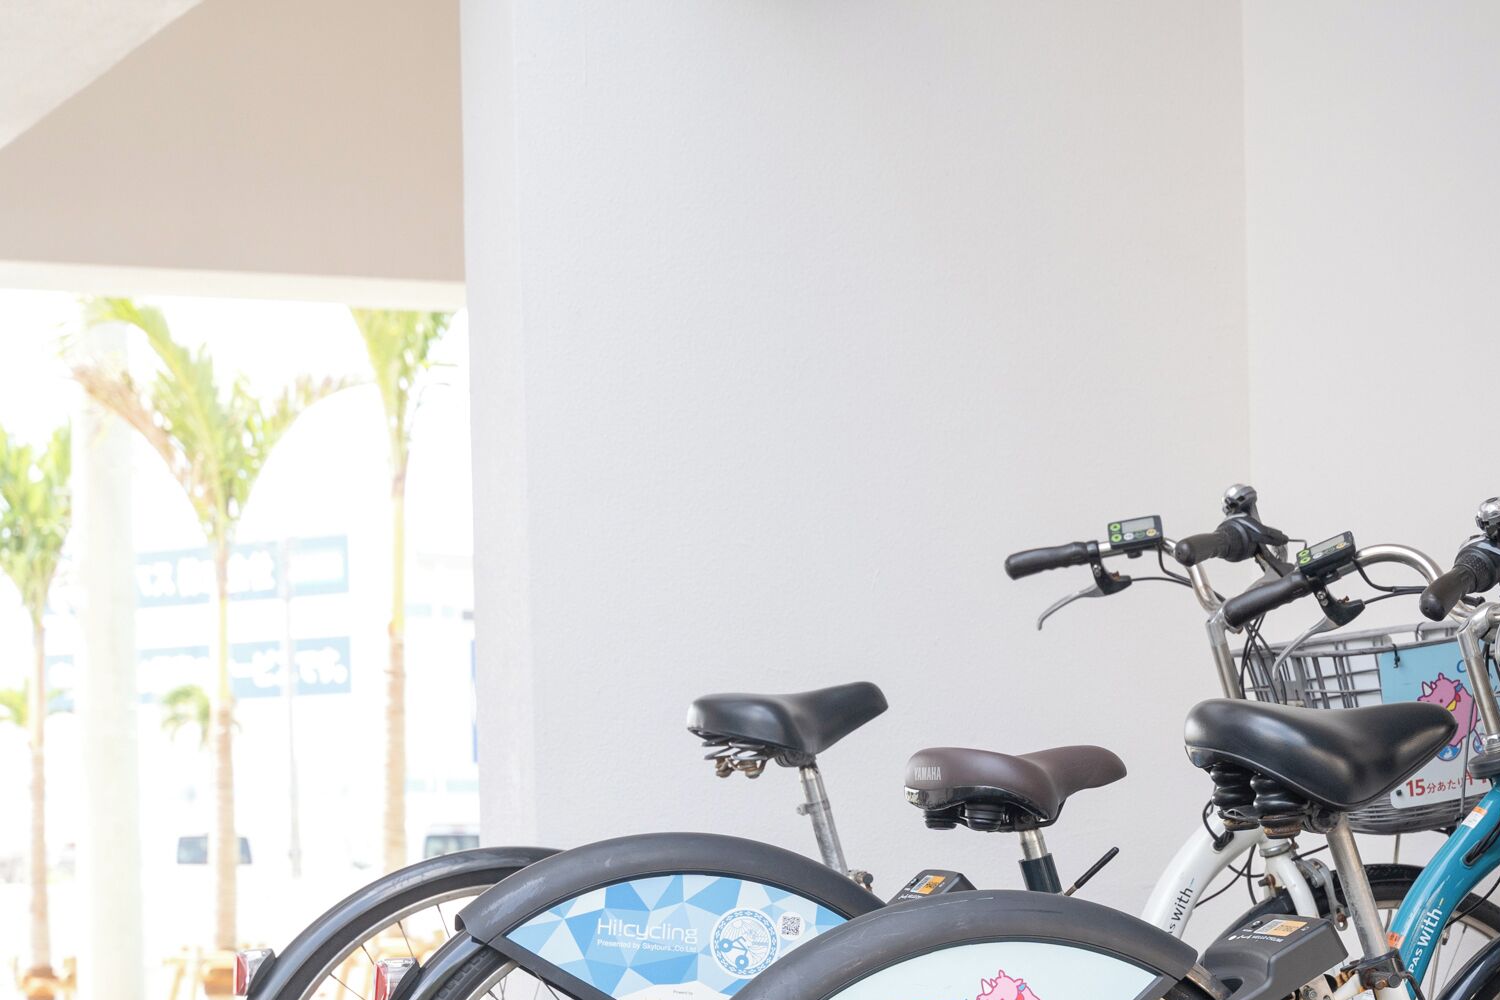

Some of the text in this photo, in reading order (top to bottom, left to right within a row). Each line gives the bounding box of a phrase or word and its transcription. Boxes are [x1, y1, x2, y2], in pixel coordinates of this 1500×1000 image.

[914, 766, 942, 781] YAMAHA
[1170, 887, 1193, 921] with
[597, 918, 698, 945] Hi!cycling
[597, 939, 632, 949] Presented
[632, 942, 641, 951] by
[1408, 907, 1443, 974] PAS with
